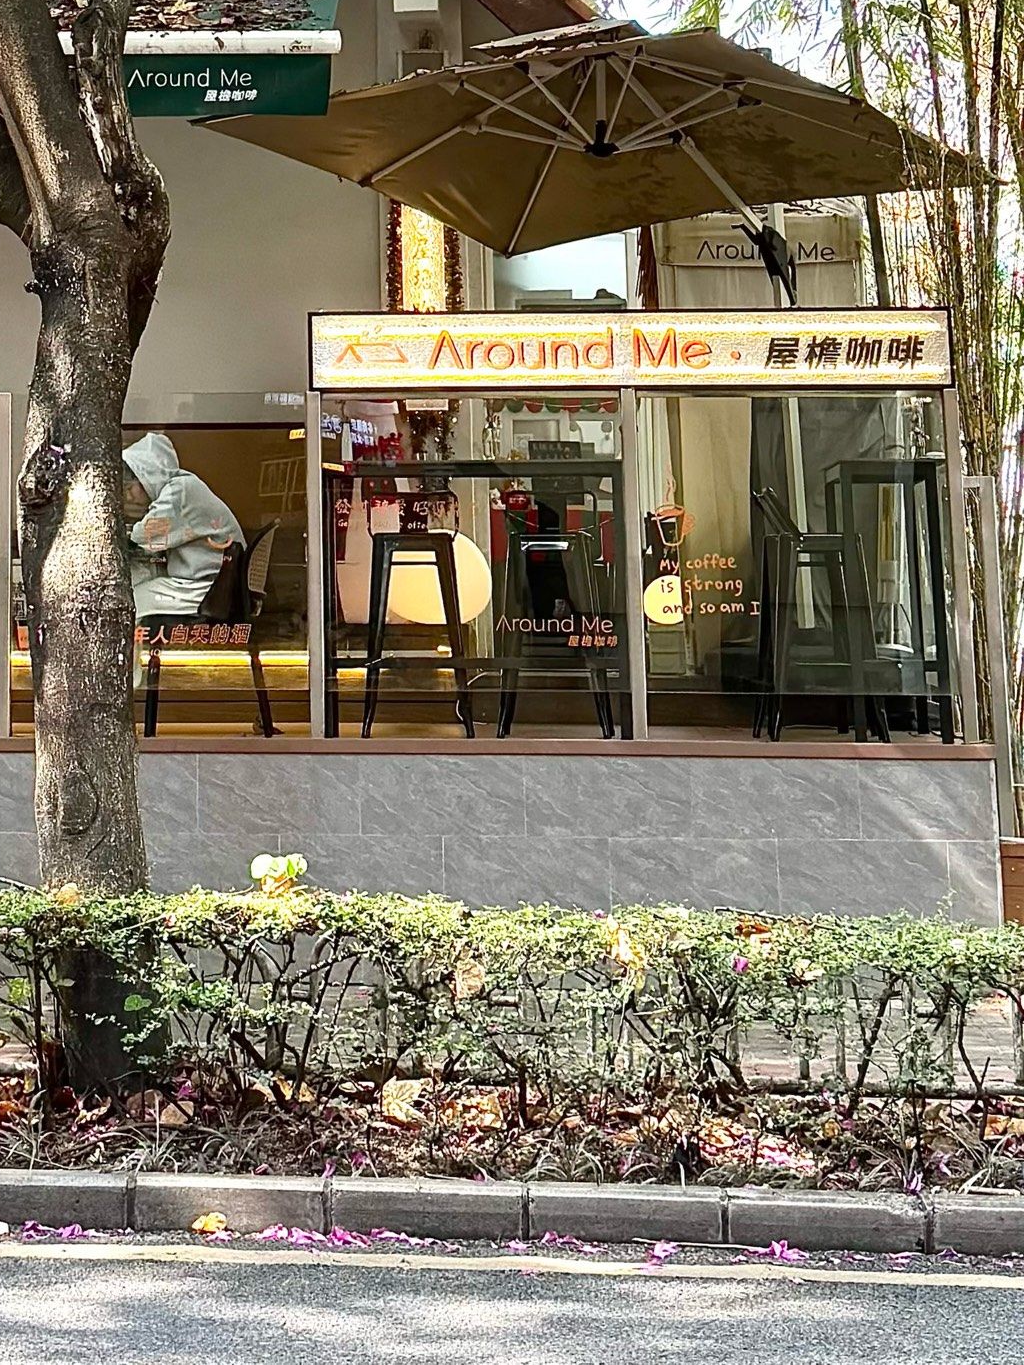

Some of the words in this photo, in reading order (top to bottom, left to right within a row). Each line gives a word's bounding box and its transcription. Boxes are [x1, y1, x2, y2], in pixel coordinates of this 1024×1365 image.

[128, 68, 210, 88] Around
[220, 68, 252, 87] Me
[697, 240, 761, 260] Arou
[798, 241, 836, 261] Me
[428, 327, 614, 370] Around
[633, 327, 713, 370] Me
[764, 334, 925, 370] 屋檐咖啡
[659, 558, 679, 574] My
[685, 553, 737, 569] coffee
[660, 579, 674, 593] is
[684, 574, 743, 596] strong
[662, 591, 693, 615] and
[699, 602, 716, 614] so
[720, 602, 745, 614] am
[749, 601, 761, 615] I
[496, 614, 574, 632] Around
[581, 615, 614, 633] Me
